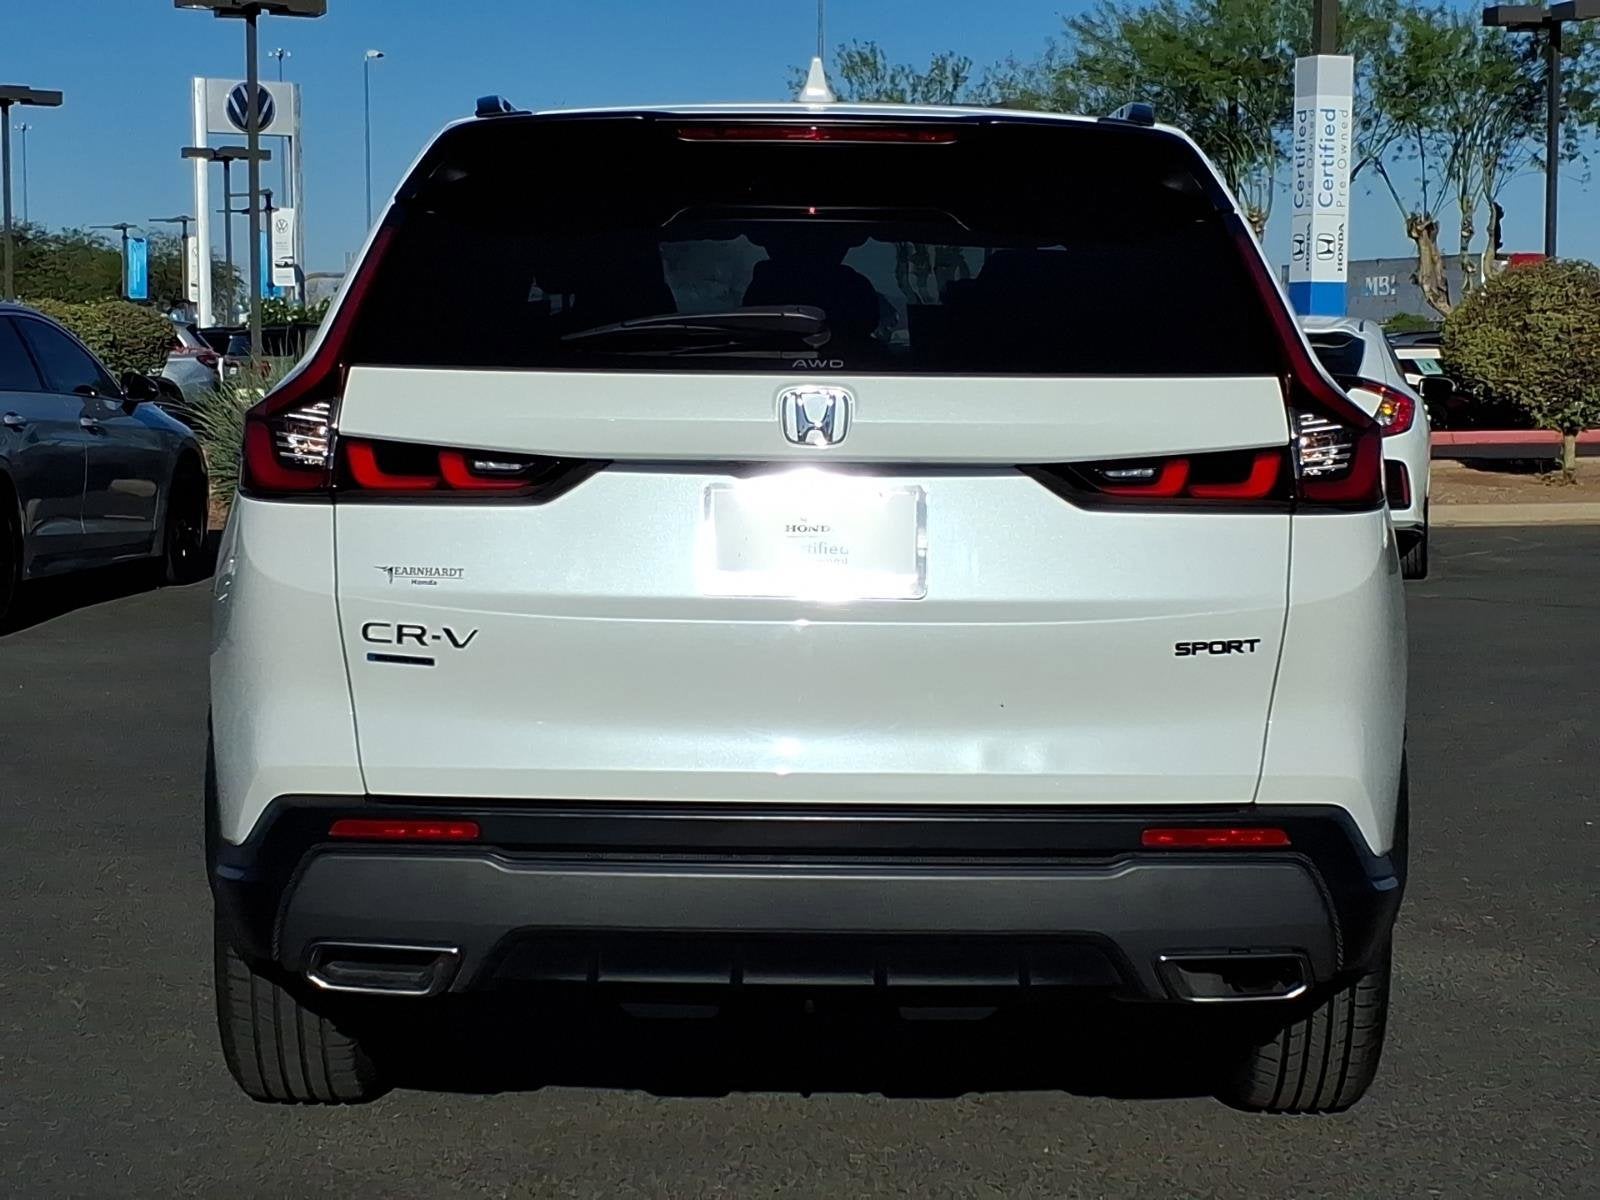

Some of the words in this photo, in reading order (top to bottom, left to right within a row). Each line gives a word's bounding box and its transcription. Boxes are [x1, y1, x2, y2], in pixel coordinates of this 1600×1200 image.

[1294, 110, 1306, 208] Certified
[1318, 108, 1336, 207] Certified
[1336, 110, 1348, 208] Pre-Owned
[1337, 223, 1345, 271] HONDA
[792, 359, 844, 368] AWD
[785, 524, 832, 532] HOND
[394, 566, 464, 577] EARNHARDT
[361, 622, 478, 649] CR-V
[1174, 638, 1261, 656] SPORT
